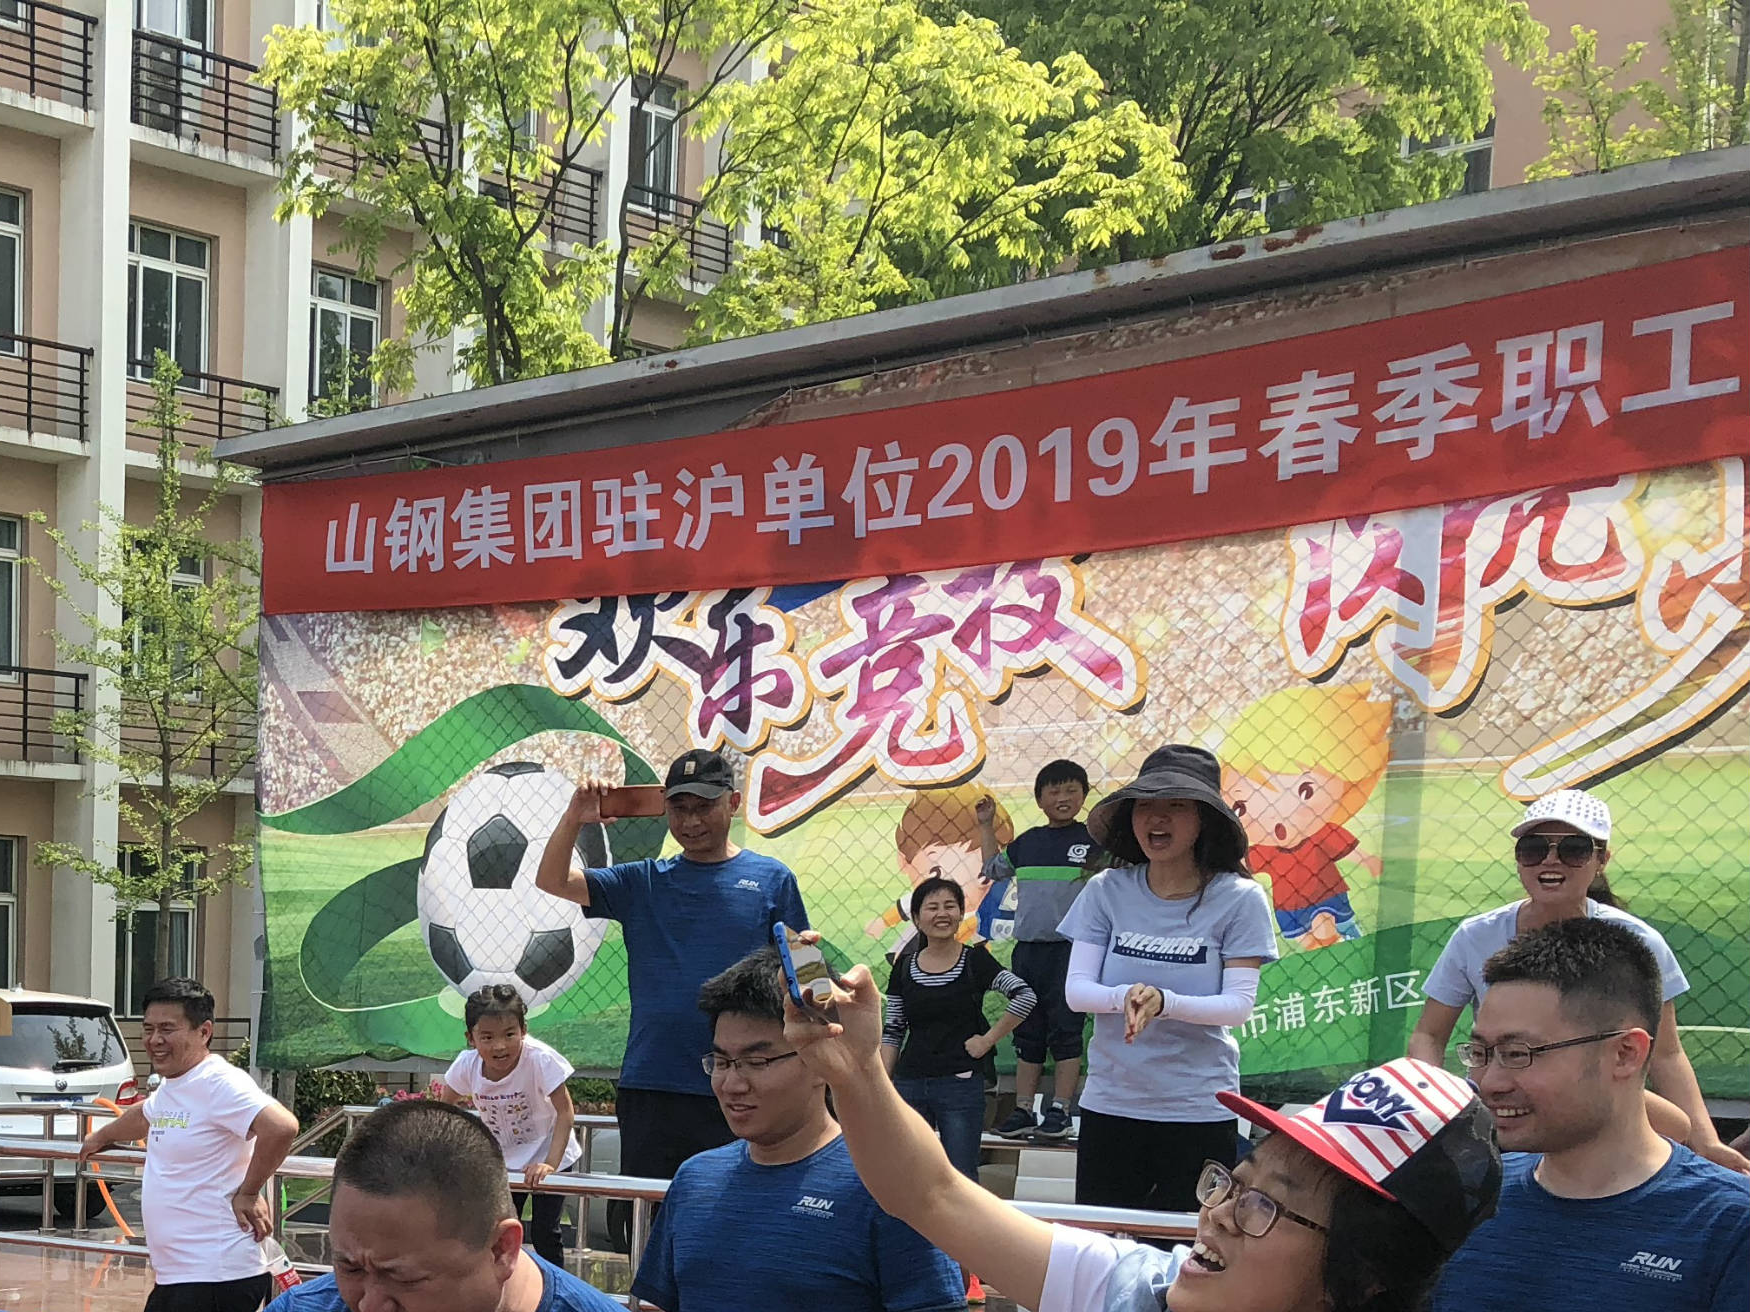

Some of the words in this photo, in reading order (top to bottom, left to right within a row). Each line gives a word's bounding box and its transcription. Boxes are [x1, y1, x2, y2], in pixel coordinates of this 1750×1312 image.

[325, 301, 1740, 573] 山钢集团驻沪单位2019年春季职工
[1117, 931, 1204, 957] SKECHERS
[797, 1195, 834, 1210] RUN
[1628, 1251, 1683, 1271] RUN
